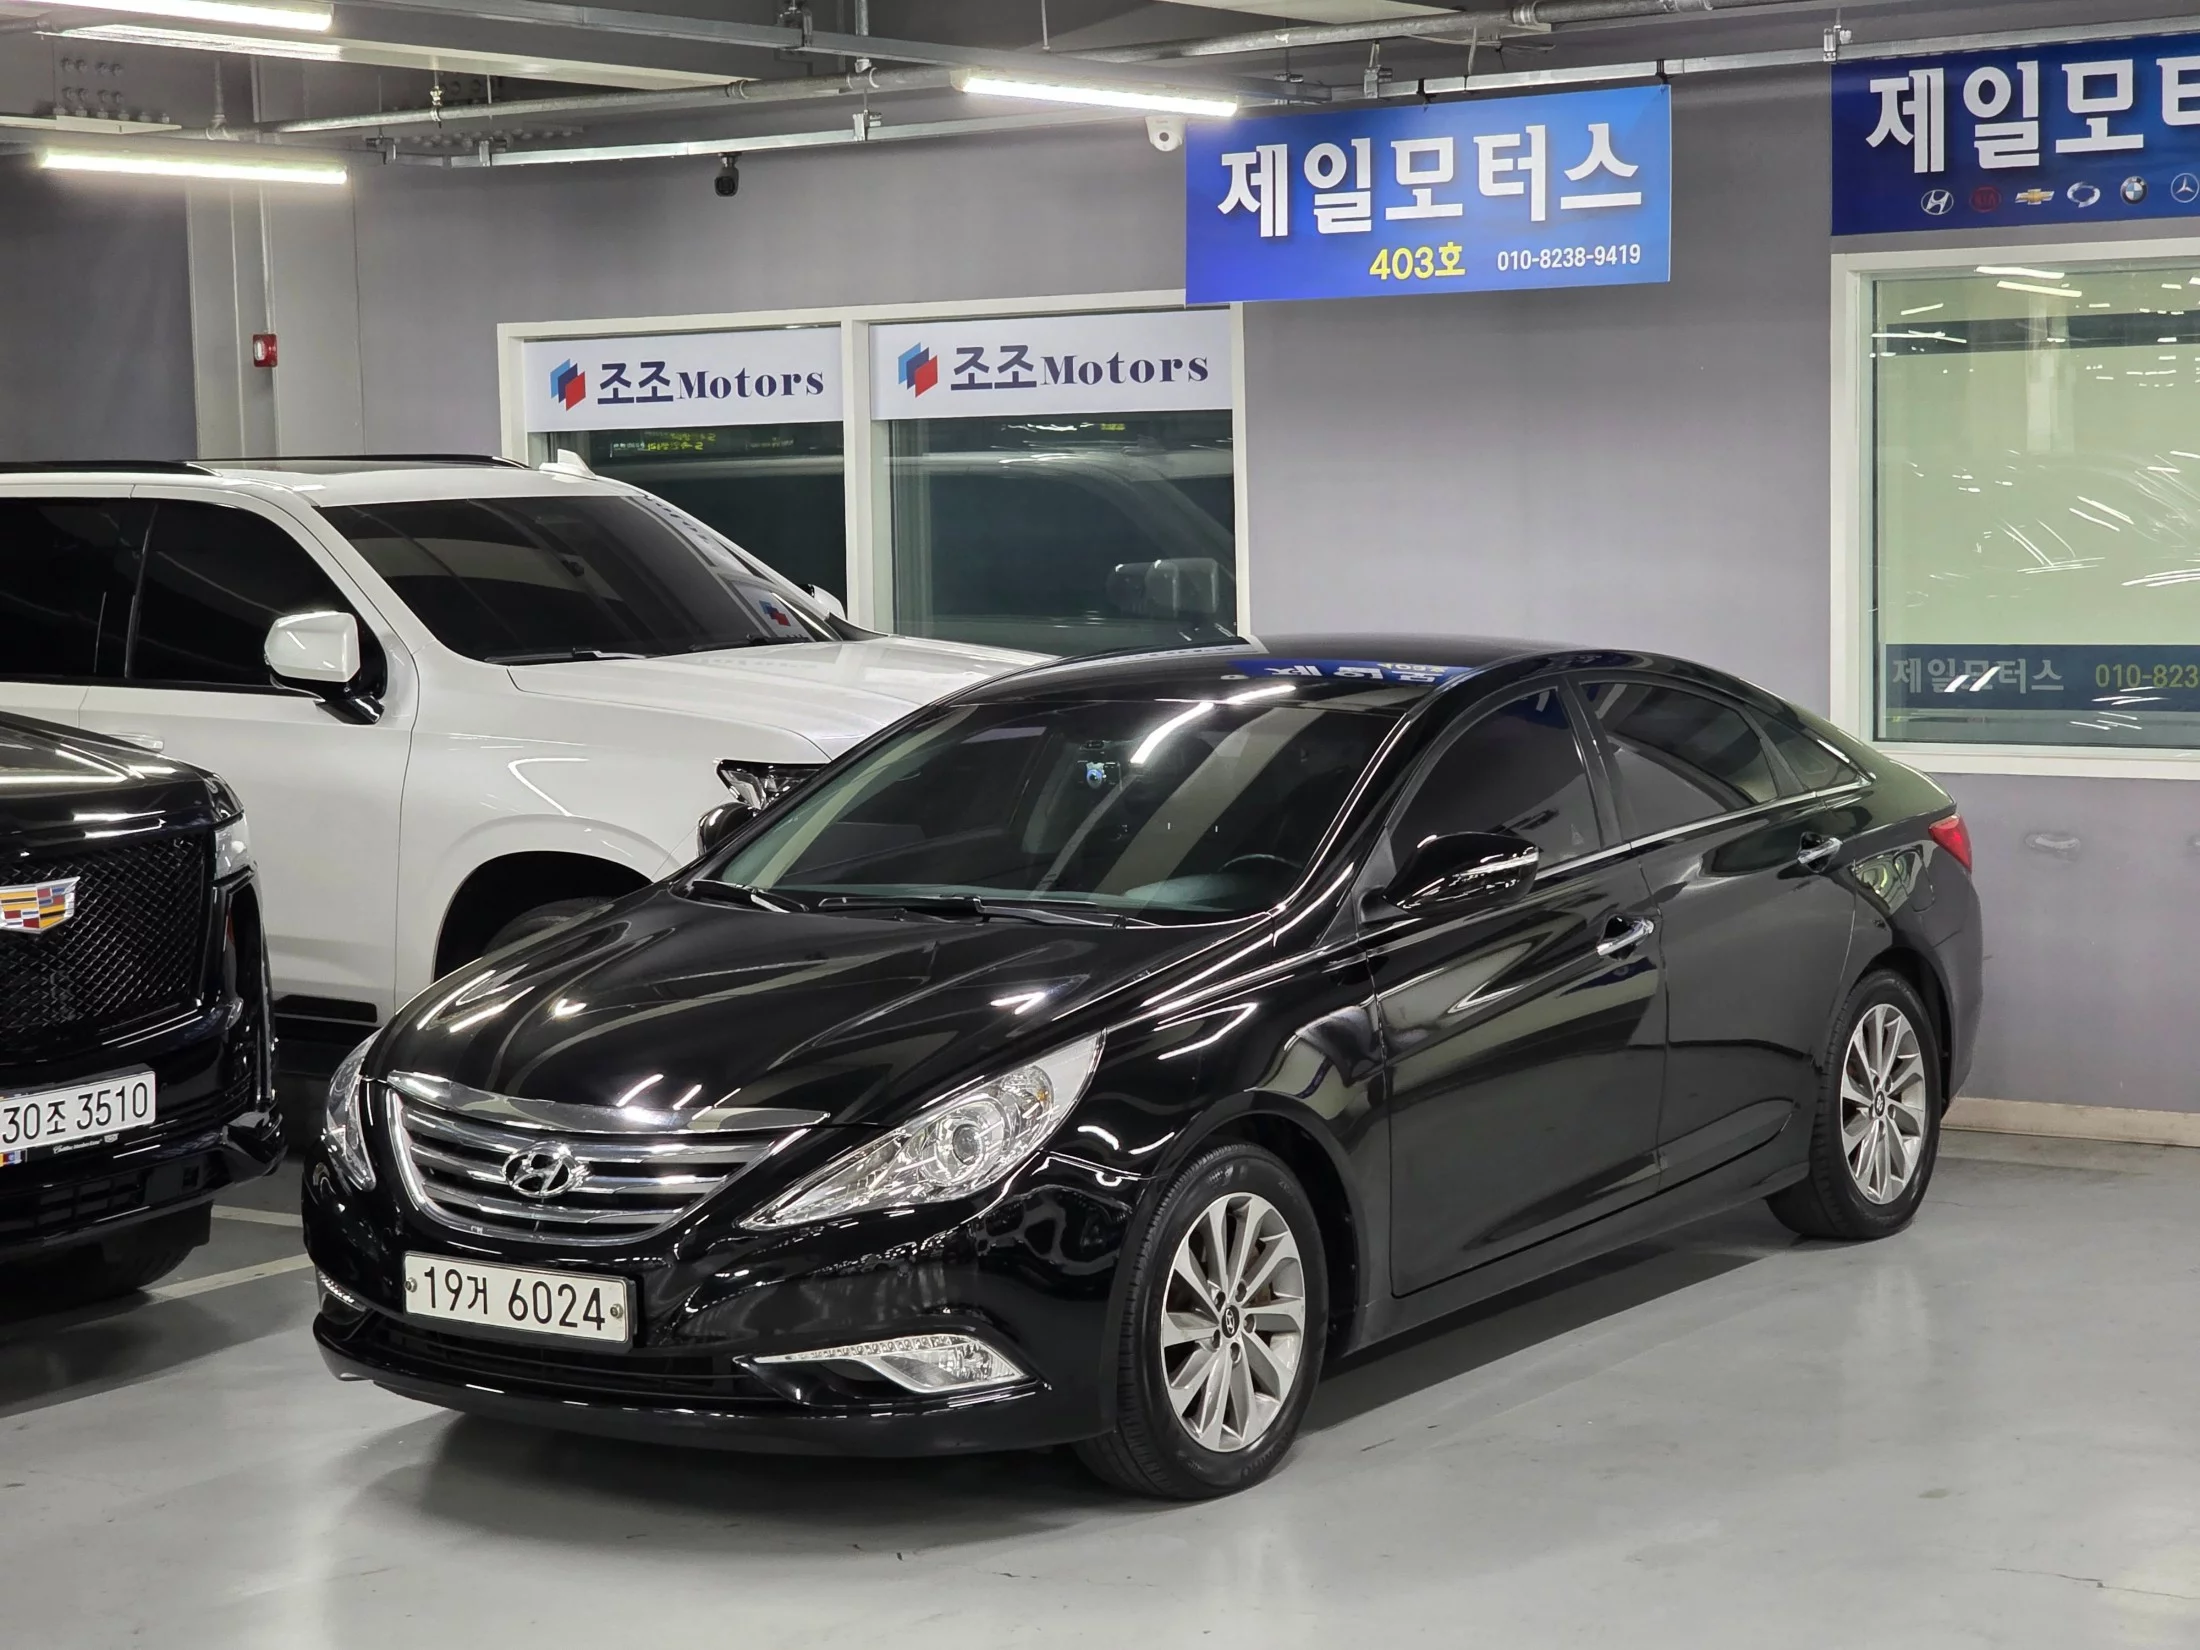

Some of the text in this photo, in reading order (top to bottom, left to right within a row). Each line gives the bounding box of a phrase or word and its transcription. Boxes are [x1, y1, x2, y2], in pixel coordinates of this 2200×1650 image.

[1218, 123, 1642, 238] 제일모터스
[1369, 241, 1641, 280] 403호 010-8238-9419
[1892, 658, 2200, 694] 제일모터스 010-823
[2, 1082, 148, 1144] 30조 3510
[424, 1266, 606, 1331] 19거 6024
